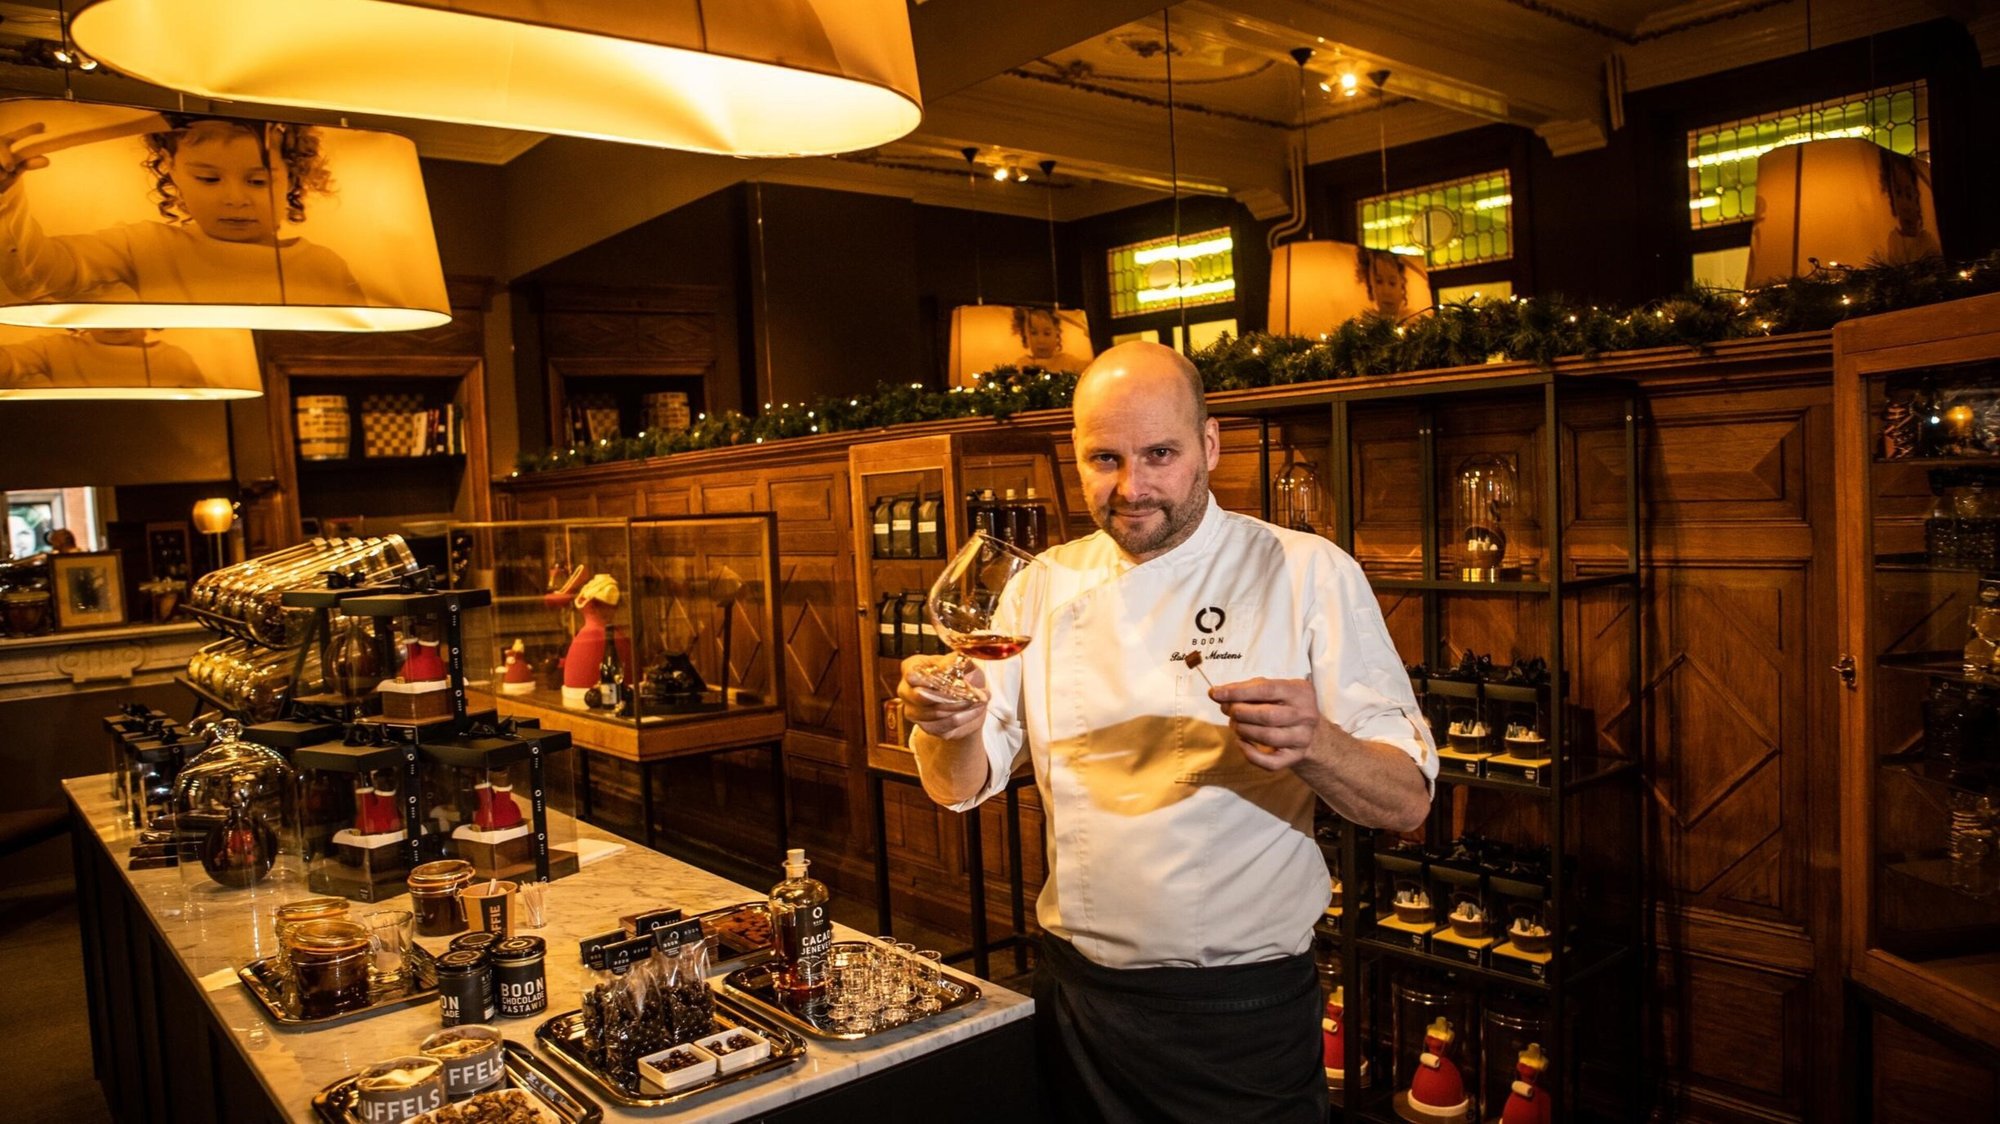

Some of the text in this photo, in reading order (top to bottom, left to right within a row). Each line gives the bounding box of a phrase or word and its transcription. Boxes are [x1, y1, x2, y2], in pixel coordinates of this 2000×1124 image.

[1192, 637, 1224, 645] BOON
[1205, 650, 1242, 660] Mertens
[802, 929, 831, 947] CACAO
[501, 977, 544, 997] BOON
[502, 991, 545, 1005] CHOCOLADE
[359, 1088, 441, 1121] UFFELS
